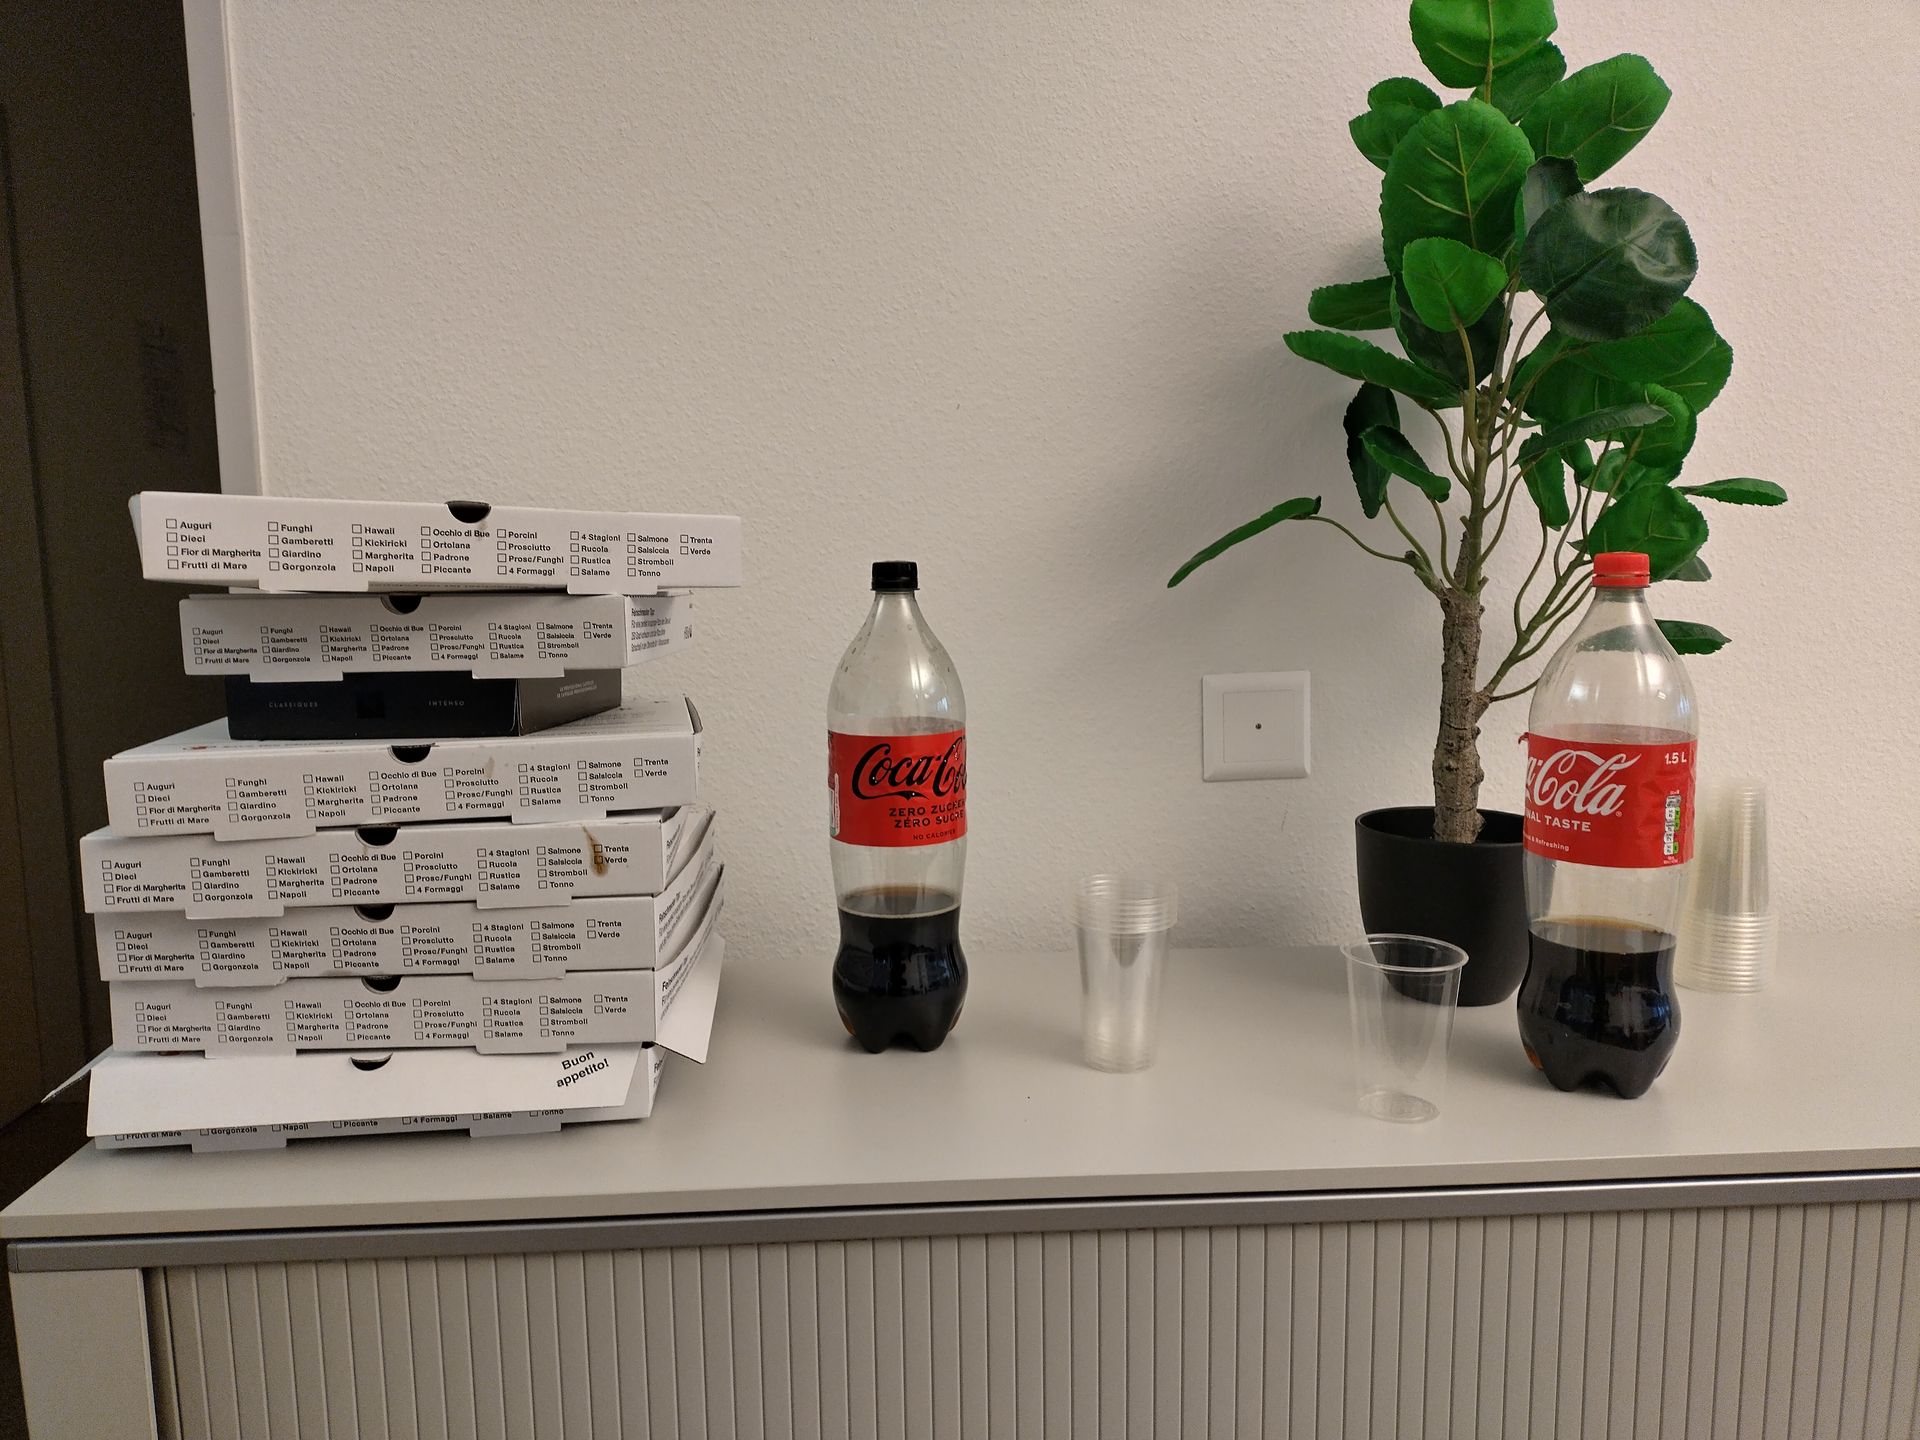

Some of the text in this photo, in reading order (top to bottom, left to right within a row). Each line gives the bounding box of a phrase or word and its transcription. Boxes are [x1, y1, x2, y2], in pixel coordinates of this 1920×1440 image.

[180, 520, 212, 531] Auguri
[281, 524, 313, 534] Funghi
[364, 526, 395, 535] Hawaii
[433, 528, 490, 538] Occhio di Bue
[508, 530, 538, 539] Porcini
[180, 534, 206, 543] Dieci
[281, 537, 334, 546] Gamberetti
[581, 533, 621, 542] 4 Stagioni
[637, 534, 669, 543] Salmone
[690, 536, 713, 544] Trenta
[364, 539, 407, 548] Kickiricki
[433, 541, 471, 549] Ortolana
[508, 543, 551, 551] Prosciutto
[581, 544, 608, 553] Rucola
[638, 545, 670, 554] Salsiccia
[690, 547, 711, 556] Verde
[181, 548, 261, 559] Fior di Margherita
[282, 550, 322, 559] Giardino
[365, 551, 414, 562] Margherita
[433, 553, 470, 562] Padrone
[509, 555, 564, 564] Prosc/Funghi
[581, 556, 611, 565] Rustica
[638, 557, 674, 566] Stromboli
[181, 560, 208, 569] Frutti
[209, 561, 220, 569] di
[282, 563, 336, 573] Gorgonzola
[365, 564, 395, 574] Napoli
[433, 565, 471, 574] Piccante
[509, 567, 555, 577] 4 Formaggi
[581, 568, 610, 576] Salame
[638, 569, 661, 577] Tonno
[202, 628, 224, 636] Auguri
[547, 632, 575, 640] Salsiccia
[272, 656, 311, 664] Gorgonzola
[332, 655, 353, 663] Napoli
[645, 758, 669, 766] Trenta
[1664, 752, 1688, 765] 1.5 L
[589, 761, 622, 769] Salmone
[589, 772, 623, 780] Salsiccia
[645, 769, 668, 778] Verde
[315, 774, 345, 783] Hawaii
[456, 779, 499, 787] Prosciutto
[530, 775, 559, 784] Rucola
[147, 783, 176, 793] Auguri
[238, 779, 267, 788] Funghi
[382, 783, 419, 791] Ortolana
[590, 783, 629, 791] Stromboli
[239, 790, 287, 798] Gamberetti
[316, 786, 357, 794] Kickiricki
[457, 790, 513, 799] Prosc/Funghi
[317, 797, 365, 807] Margherita
[383, 794, 418, 803] Padrone
[531, 797, 562, 806] Salame
[240, 802, 277, 810] Giardino
[384, 806, 421, 814] Piccante
[318, 809, 346, 818] Napoli
[889, 807, 926, 817] ZERO
[241, 813, 291, 822] Gorgonzola
[894, 817, 930, 828] ZÉRO
[1544, 815, 1591, 832] TASTE
[548, 847, 582, 855] Salmone
[605, 845, 630, 853] Trenta
[415, 851, 444, 860] Porcini
[202, 859, 231, 868] Funghi
[489, 860, 518, 869] Rucola
[549, 858, 583, 866] Salsiccia
[605, 856, 628, 865] Verde
[114, 861, 142, 871] Auguri
[342, 865, 379, 873] Ortolana
[416, 863, 459, 871] Prosciutto
[203, 870, 250, 878] Gamberetti
[278, 867, 318, 875] Kickiricki
[549, 869, 588, 877] Stromboli
[115, 873, 137, 881] Dieci
[416, 874, 472, 883] Prosc/Funghi
[490, 872, 521, 880] Rustica
[204, 882, 239, 890] Giardino
[279, 879, 325, 888] Margherita
[490, 883, 521, 891] Salame
[550, 881, 575, 889] Tonno
[280, 890, 307, 900] Napoli
[344, 888, 381, 896] Piccante
[204, 893, 253, 902] Gorgonzola
[412, 925, 441, 933] Porcini
[542, 922, 575, 930] Salmone
[597, 920, 622, 929] Trenta
[127, 932, 153, 941] Auguri
[209, 931, 236, 940] Funghi
[280, 928, 308, 937] Hawaii
[598, 932, 621, 940] Verde
[343, 938, 378, 946] Ortolana
[413, 936, 455, 944] Prosciutto
[543, 943, 581, 952] Stromboli
[283, 950, 327, 960] Margherita
[544, 955, 568, 963] Tonno
[212, 963, 258, 972] Gorgonzola
[424, 999, 452, 1007] Porcini
[550, 996, 582, 1005] Salmone
[604, 995, 629, 1004] Trenta
[226, 1003, 252, 1012] Funghi
[295, 1001, 322, 1009] Hawaii
[296, 1012, 333, 1020] Kickiricki
[494, 1009, 521, 1017] Rucola
[356, 1022, 389, 1030] Padrone
[425, 1020, 478, 1029] Prosc/Funghi
[551, 1018, 588, 1026] Stromboli
[228, 1024, 261, 1032] Giardino
[298, 1034, 323, 1043] Napoli
[357, 1033, 391, 1041] Piccante
[561, 1051, 595, 1070] Buon
[556, 1058, 609, 1087] appetito!
[421, 1115, 458, 1124] Formaggi
[483, 1112, 512, 1120] Salame
[211, 1126, 257, 1135] Gorgonzola
[282, 1123, 309, 1132] Napoli
